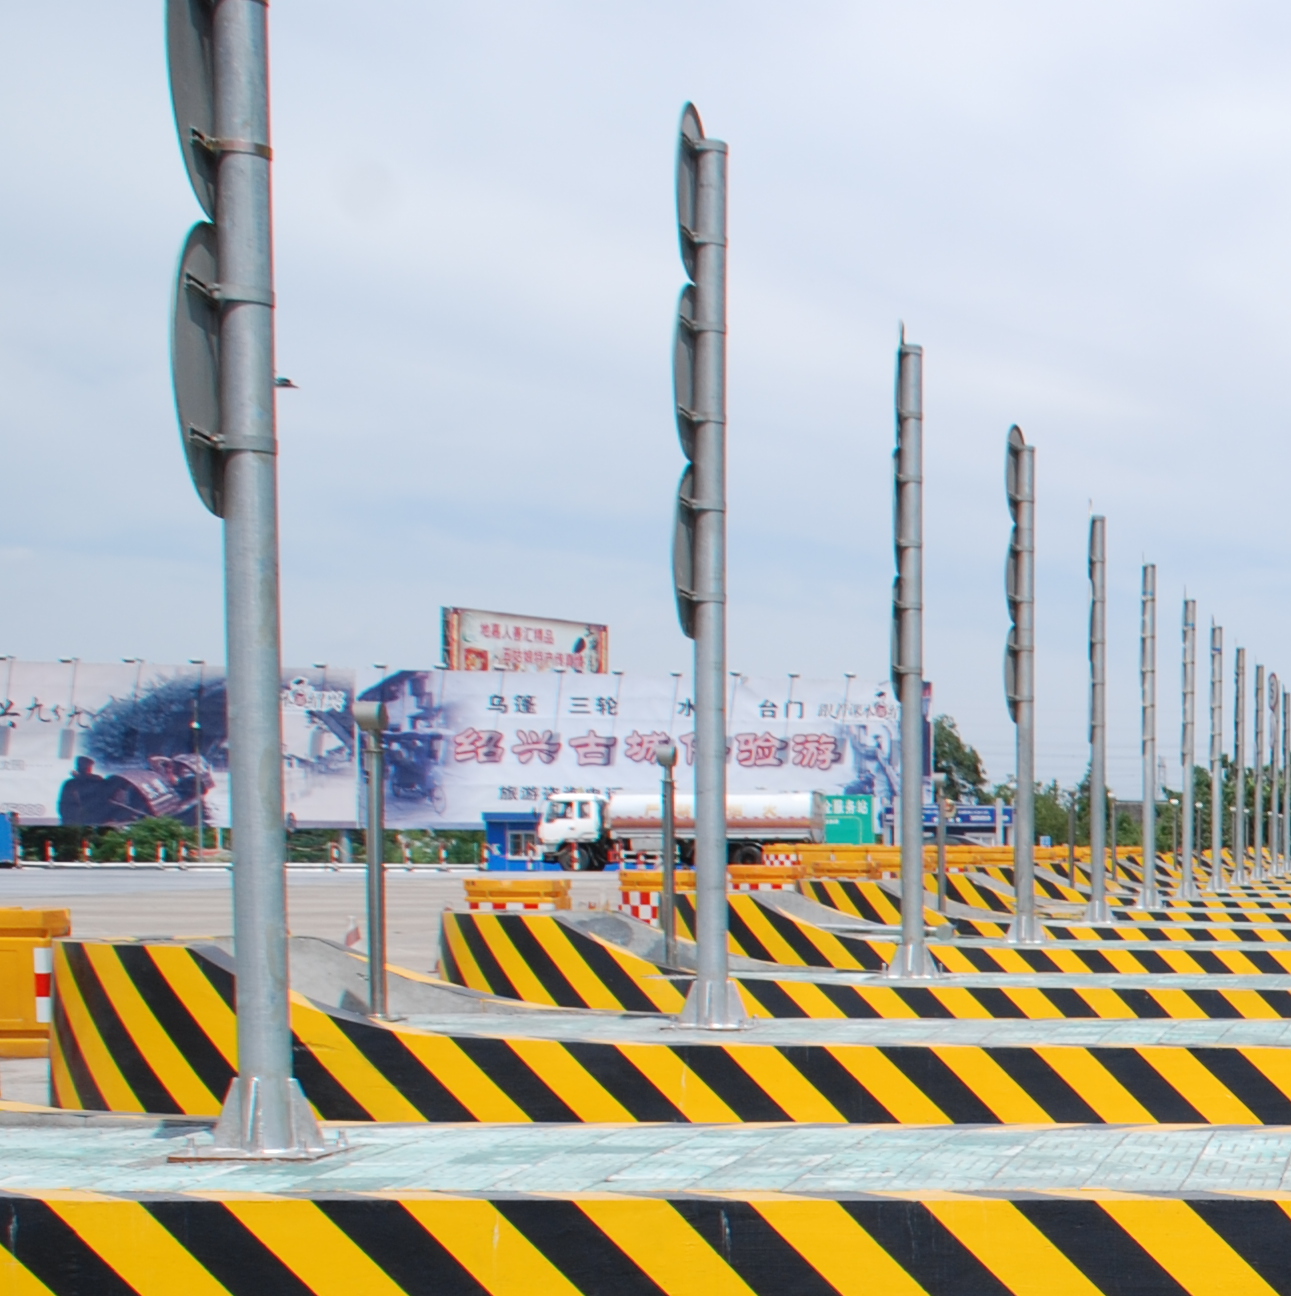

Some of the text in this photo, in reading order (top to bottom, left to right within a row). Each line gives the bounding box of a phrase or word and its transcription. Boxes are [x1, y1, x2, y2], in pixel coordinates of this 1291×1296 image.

[487, 694, 537, 716] 乌篷
[569, 695, 619, 717] 三轮
[758, 700, 804, 720] 台门
